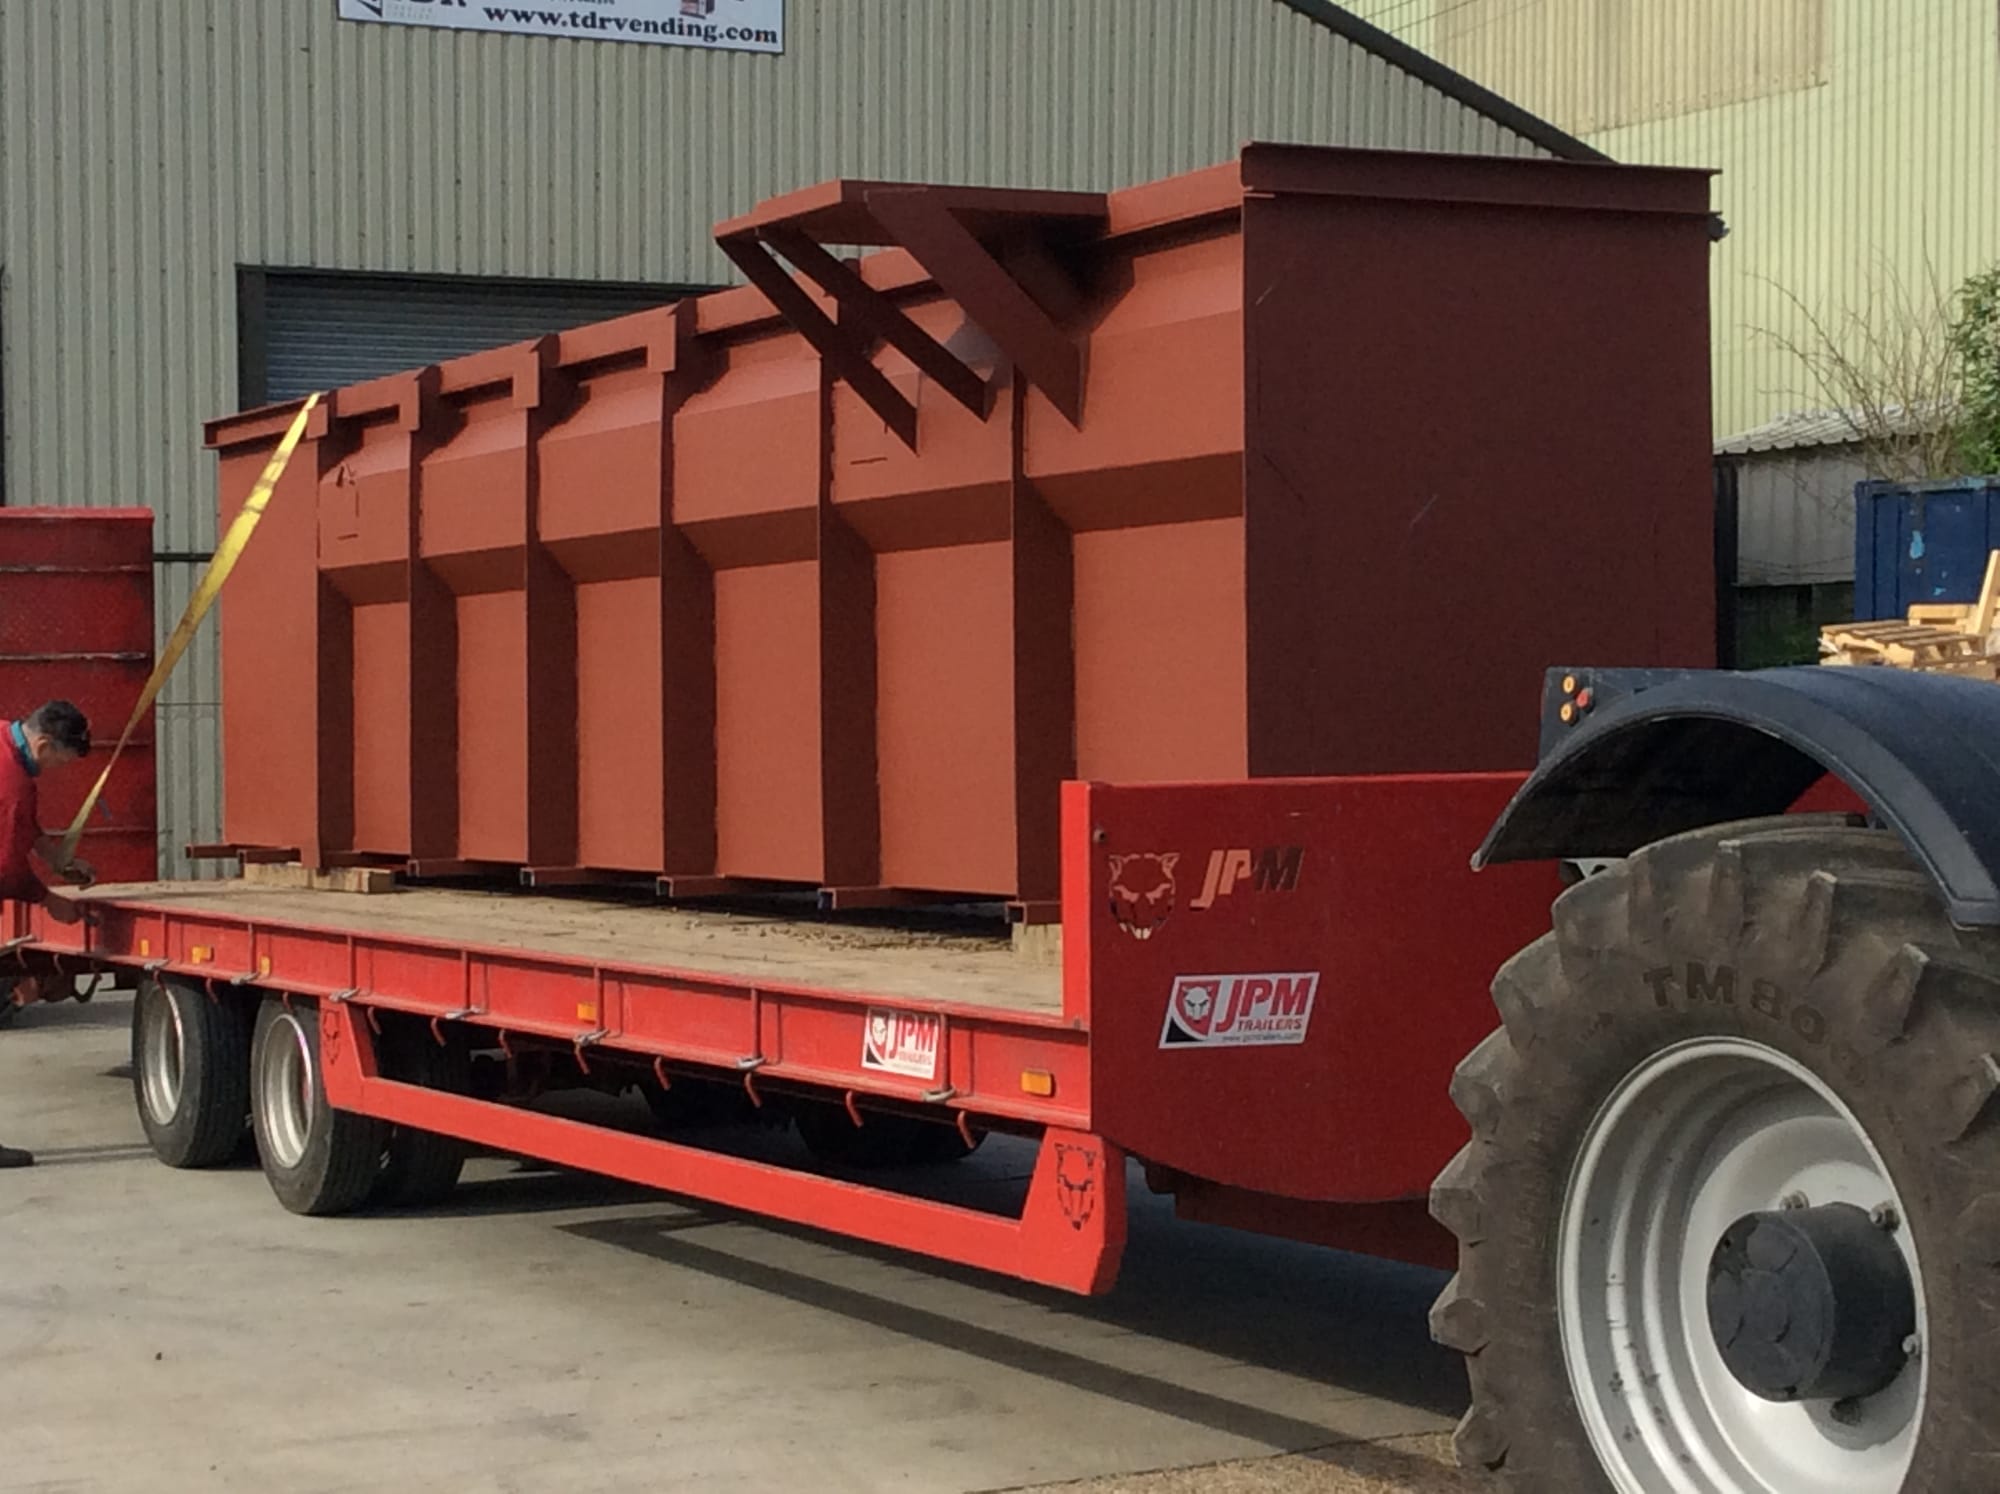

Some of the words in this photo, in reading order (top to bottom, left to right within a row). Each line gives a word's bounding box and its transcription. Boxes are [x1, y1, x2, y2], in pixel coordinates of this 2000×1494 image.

[482, 6, 778, 44] www.tdrvending.com
[1189, 847, 1304, 908] JPM
[1215, 978, 1312, 1032] JPM
[1238, 1018, 1302, 1031] TRAILERS
[888, 1012, 937, 1059] JPM
